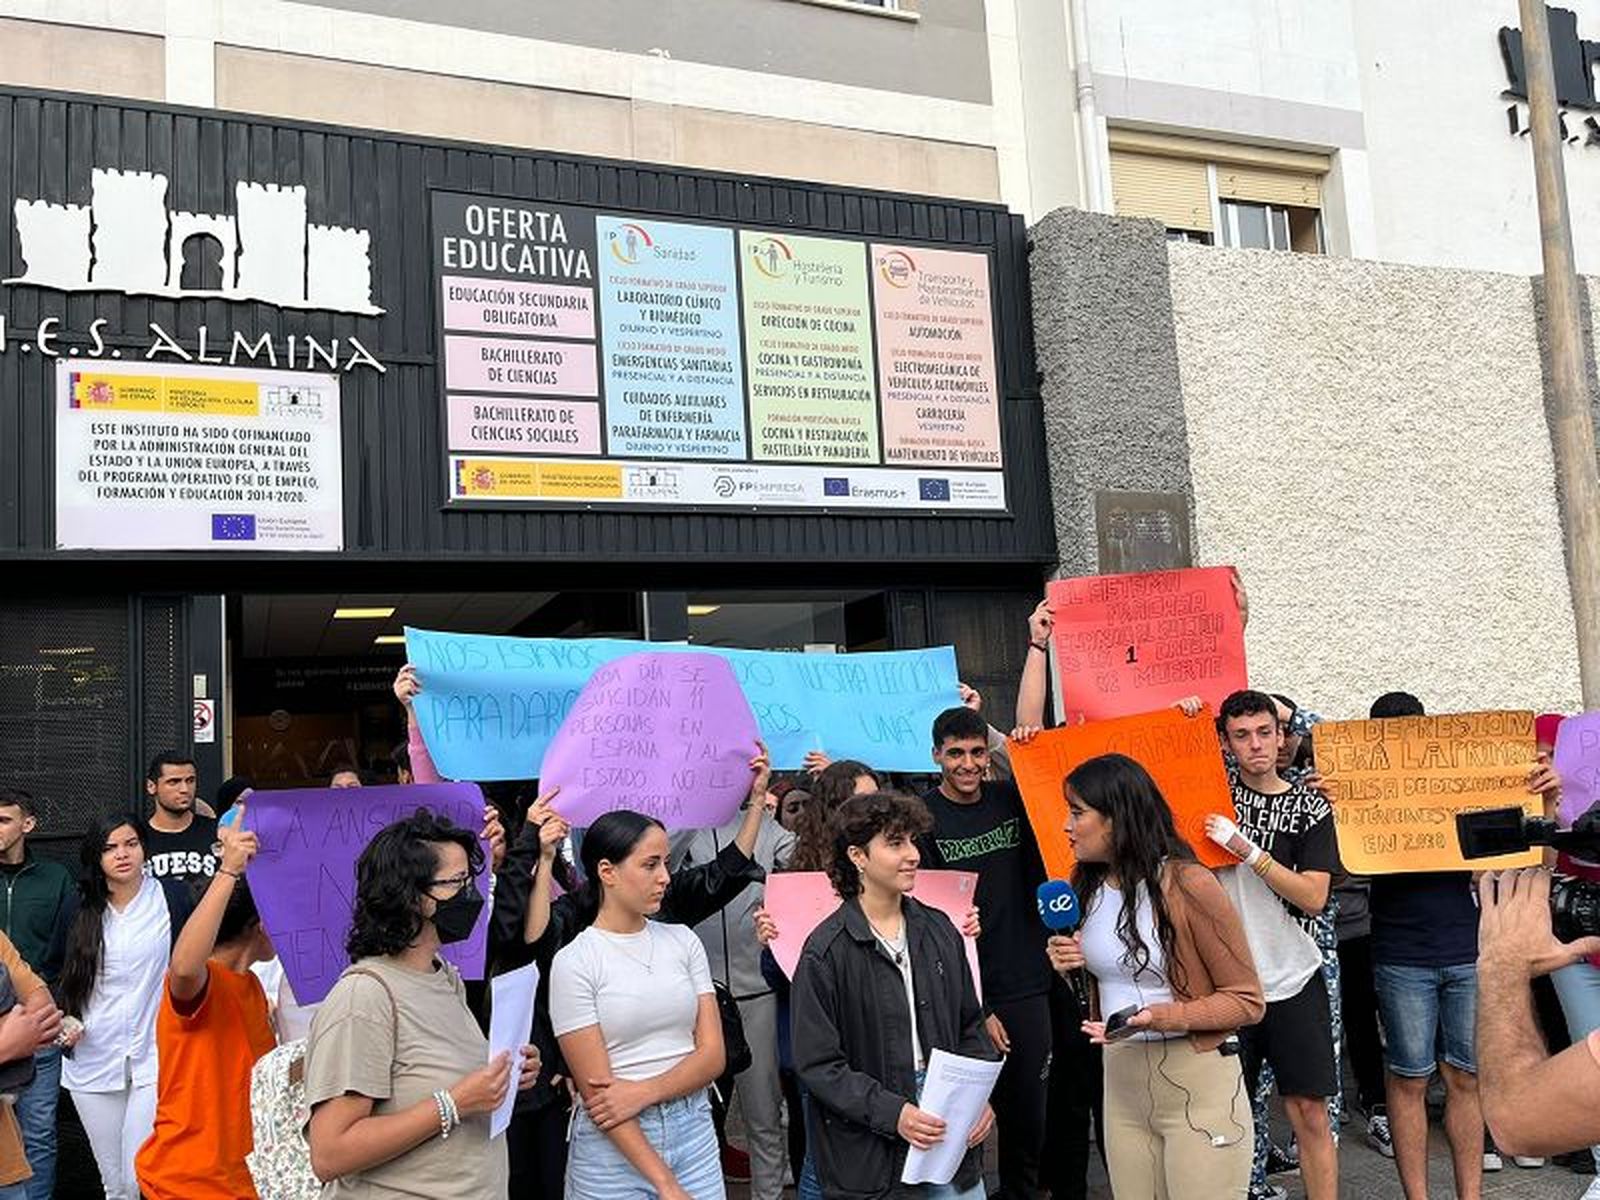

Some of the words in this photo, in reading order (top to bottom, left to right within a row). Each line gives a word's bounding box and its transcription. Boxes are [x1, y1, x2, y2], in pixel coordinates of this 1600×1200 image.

[465, 205, 568, 244] OFERTA
[443, 237, 592, 279] EDUCATIVA
[449, 286, 515, 305] EDUCACIÓN
[519, 292, 589, 311] SECUNDARIA
[617, 290, 683, 307] LABORATORIO
[483, 309, 558, 327] OBLIGATORIA
[640, 309, 647, 321] Y
[146, 322, 387, 372] ALMINA
[481, 347, 562, 366] BACHILLERATO
[612, 354, 678, 371] EMERGENCIAS
[681, 358, 733, 373] SANITARIAS
[488, 368, 504, 382] DE
[507, 369, 557, 385] CIENCIAS
[624, 391, 672, 406] CUIDADOS
[473, 405, 556, 423] BACHILLERATO
[559, 409, 574, 424] DE
[640, 410, 652, 422] DE
[91, 423, 116, 435] ESTE
[121, 424, 178, 436] INSTITUTO
[183, 426, 199, 437] HA
[202, 428, 229, 439] SIDO
[232, 429, 310, 442] COFINANCIADO
[471, 426, 523, 442] CIENCIAS
[527, 427, 579, 444] SOCIALES
[696, 429, 740, 442] FARMACIA
[94, 439, 117, 450] POR
[121, 440, 136, 450] LA
[239, 444, 285, 456] GENERAL
[289, 446, 308, 457] DEL
[89, 455, 132, 466] ESTADO
[136, 456, 143, 466] Y
[147, 456, 161, 467] LA
[206, 458, 258, 472] EUROPEA,
[263, 461, 270, 470] A
[79, 470, 99, 482] DEL
[104, 471, 168, 483] PROGRAMA
[171, 472, 232, 485] OPERATIVO
[236, 474, 254, 486] FSE
[257, 475, 271, 486] DE
[276, 476, 318, 489] EMPLEO,
[170, 488, 176, 498] Y
[425, 640, 488, 672] NOS
[1126, 646, 1138, 664] 1
[432, 691, 502, 741] PARA
[570, 715, 655, 736] PERSONAS
[681, 717, 703, 736] EN
[1316, 724, 1353, 745] LA
[584, 768, 647, 788] ESTADO
[672, 769, 695, 790] NO
[1404, 777, 1428, 796] DE
[1235, 804, 1300, 833] SILENCE
[254, 806, 309, 854] LA
[1363, 833, 1398, 854] EN
[144, 851, 217, 877] UESS
